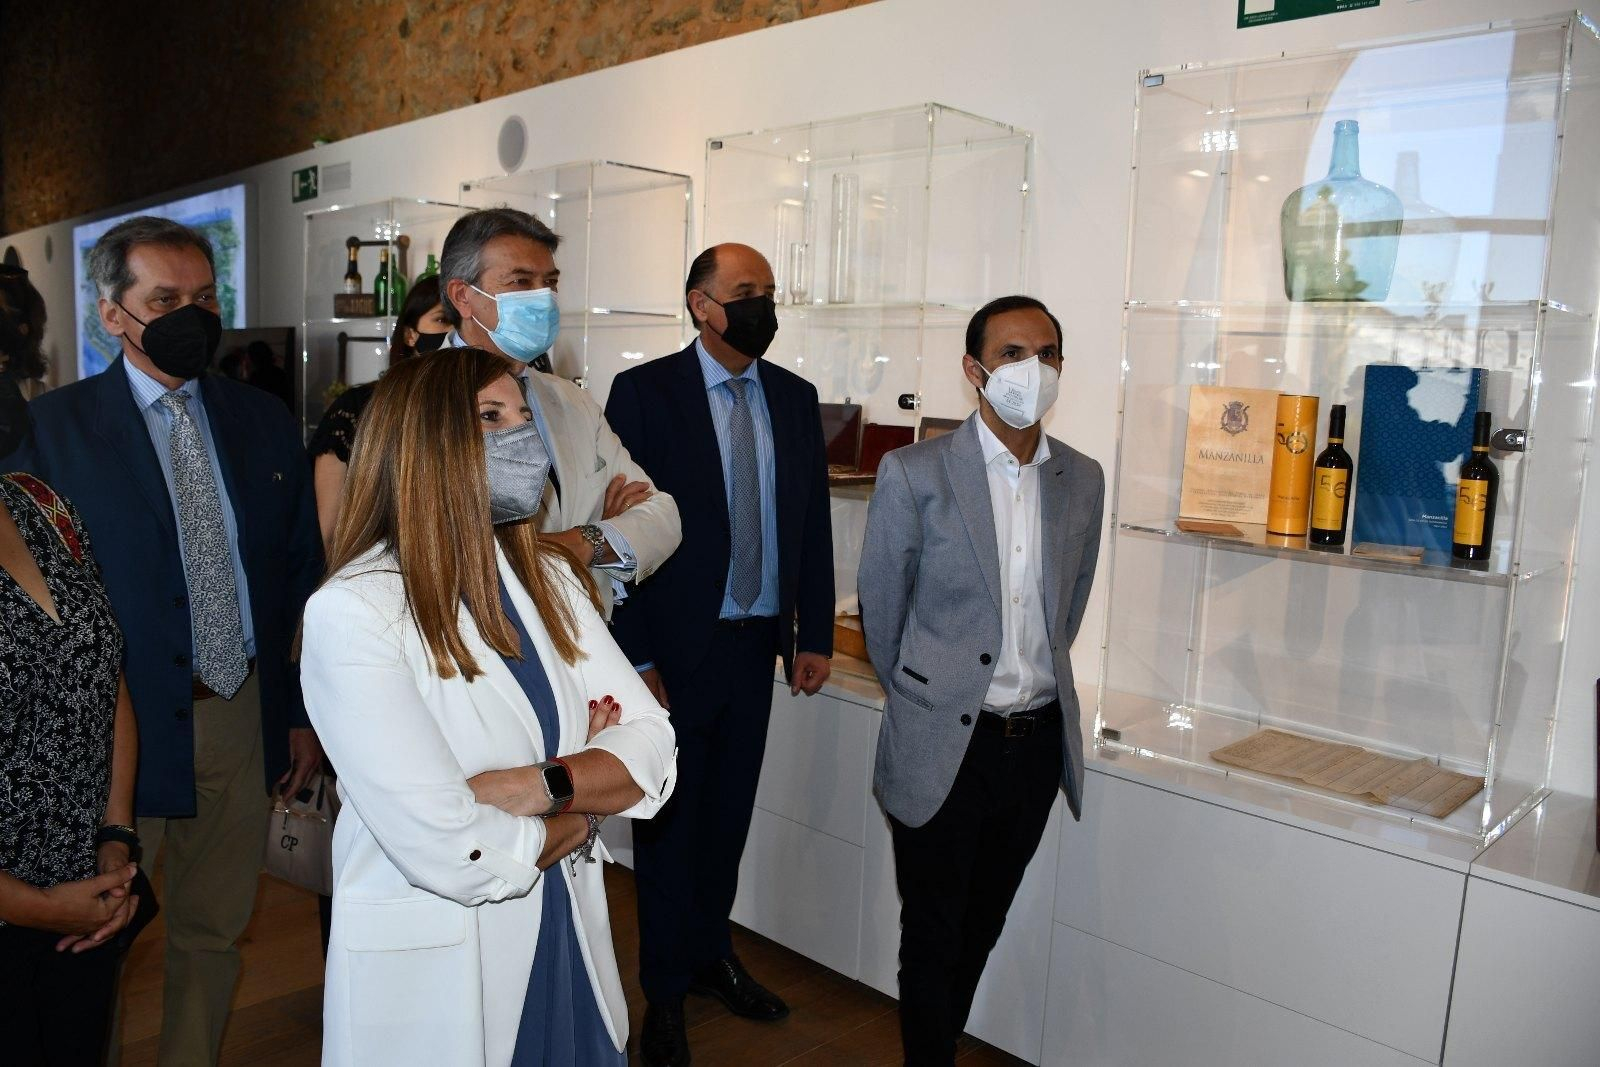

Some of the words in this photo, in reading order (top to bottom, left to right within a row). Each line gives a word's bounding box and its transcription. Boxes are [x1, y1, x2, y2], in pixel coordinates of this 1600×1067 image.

[1199, 449, 1264, 464] MANZANILLA
[1320, 475, 1345, 498] 56
[281, 835, 299, 851] CP
